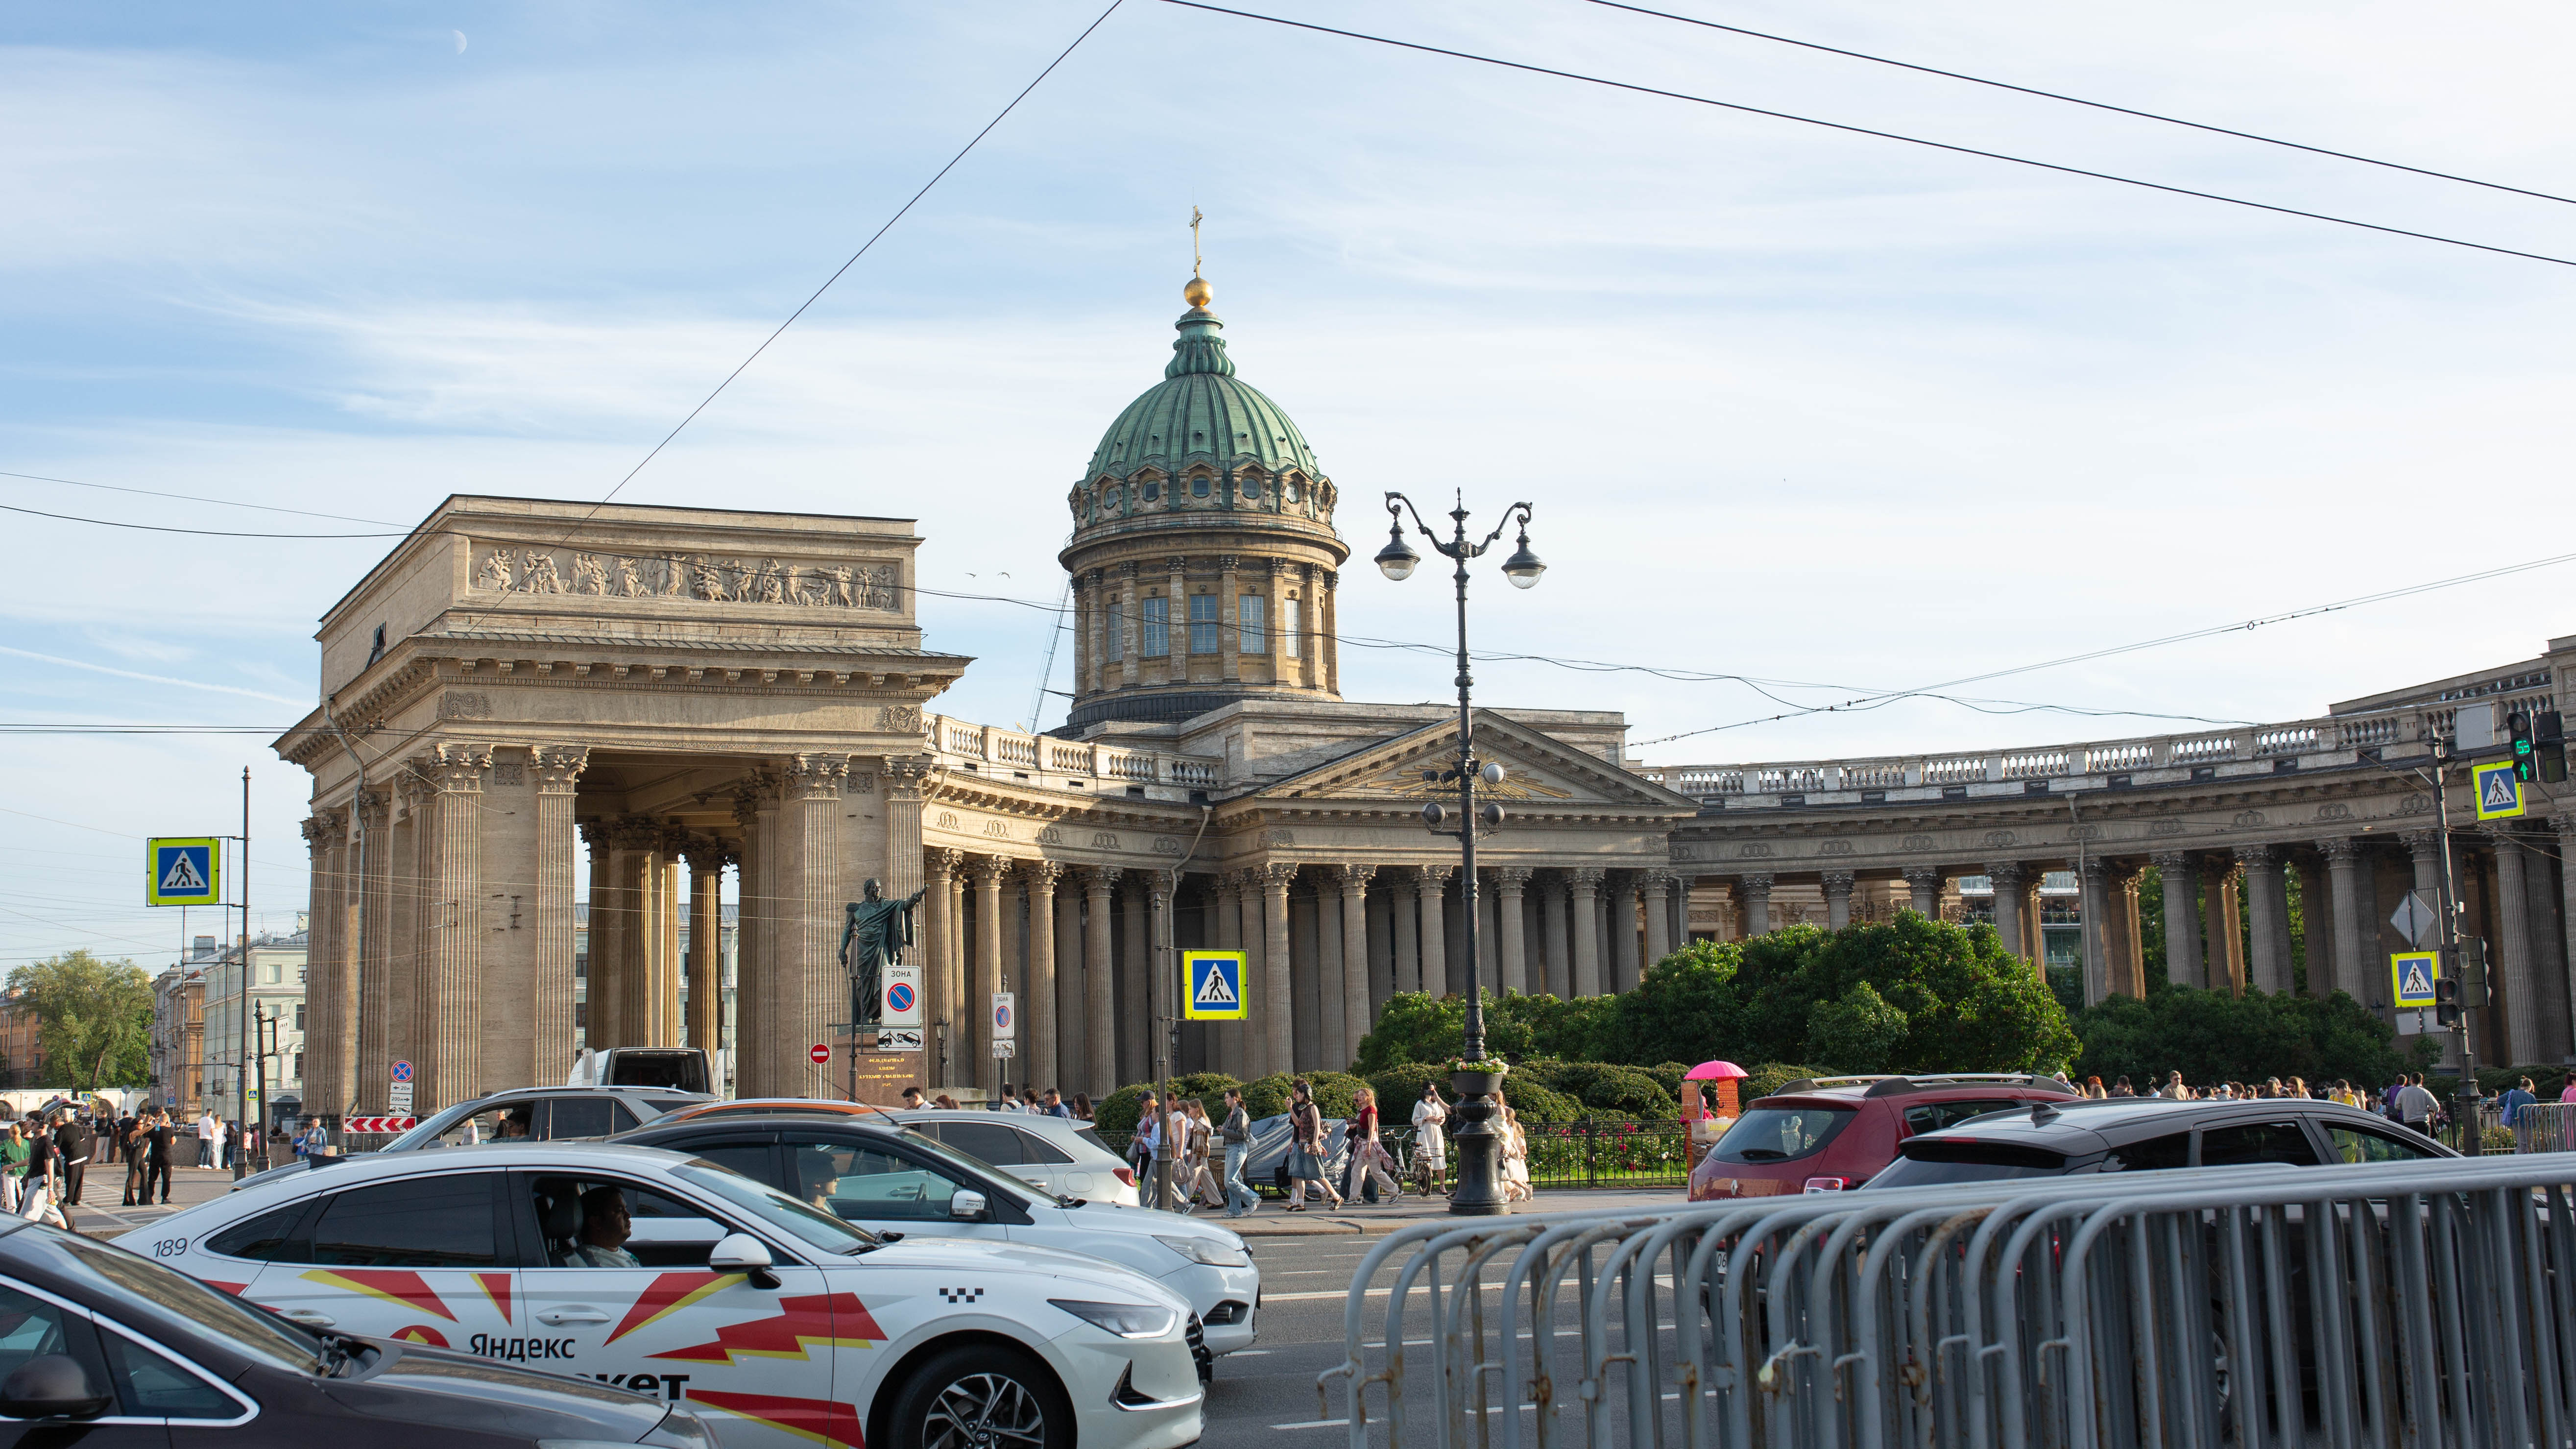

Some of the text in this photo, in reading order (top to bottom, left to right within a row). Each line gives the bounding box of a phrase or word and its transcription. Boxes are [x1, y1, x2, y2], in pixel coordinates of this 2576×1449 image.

[2516, 740, 2530, 754] 53
[153, 1238, 187, 1257] 189
[470, 1333, 576, 1362] Яндекс
